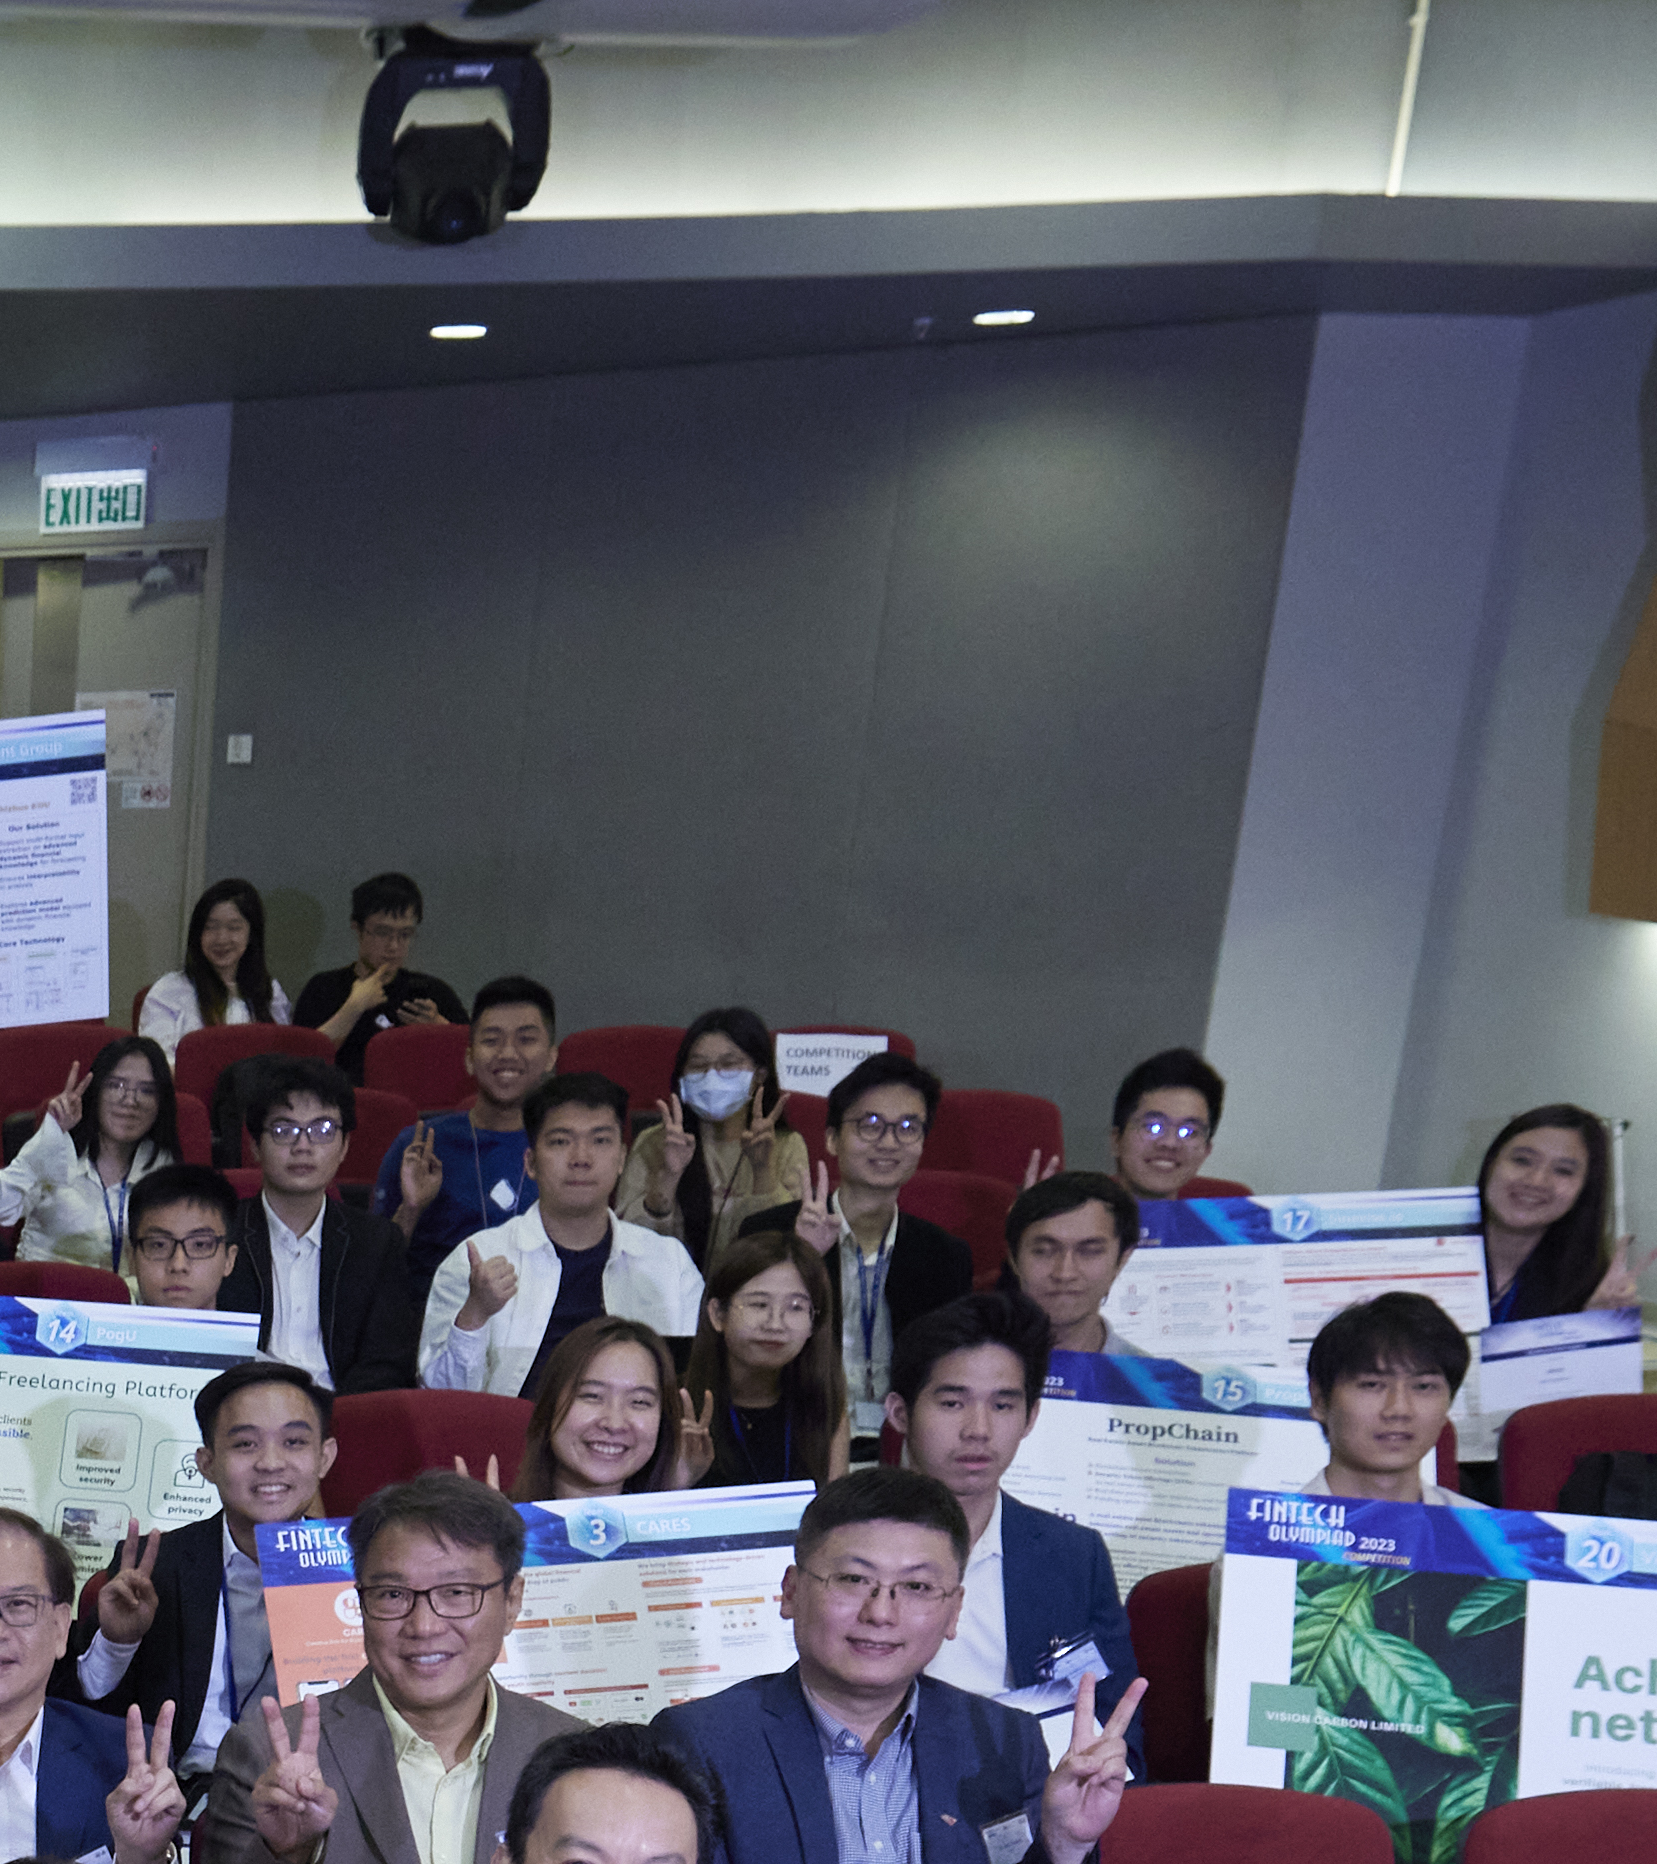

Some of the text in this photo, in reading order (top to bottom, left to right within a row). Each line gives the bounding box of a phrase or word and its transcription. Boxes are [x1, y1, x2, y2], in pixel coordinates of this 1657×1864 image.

[44, 486, 95, 528] EXIT
[98, 483, 143, 523] 出口
[19, 739, 64, 758] Group
[786, 1064, 831, 1077] TEAMS
[1282, 1210, 1312, 1232] 17
[47, 1316, 77, 1346] 14
[95, 1324, 138, 1345] PogU
[124, 1380, 200, 1401] Platfor
[1214, 1380, 1243, 1402] 15
[1107, 1417, 1241, 1444] PropChain
[76, 1464, 121, 1476] Improved
[79, 1476, 116, 1487] security
[163, 1492, 212, 1505] Enhanced
[167, 1505, 205, 1517] privacy
[1247, 1496, 1346, 1529] FINTECH
[588, 1518, 606, 1546] 3
[636, 1516, 692, 1534] CARES
[275, 1526, 348, 1552] FINTEC
[1268, 1523, 1396, 1553] OLYMPIAD 2023
[298, 1550, 353, 1568] OLYMP
[1342, 1550, 1412, 1567] COMPETITION
[1578, 1540, 1619, 1571] 20
[1265, 1710, 1426, 1735] VISION CARBON LIMITED
